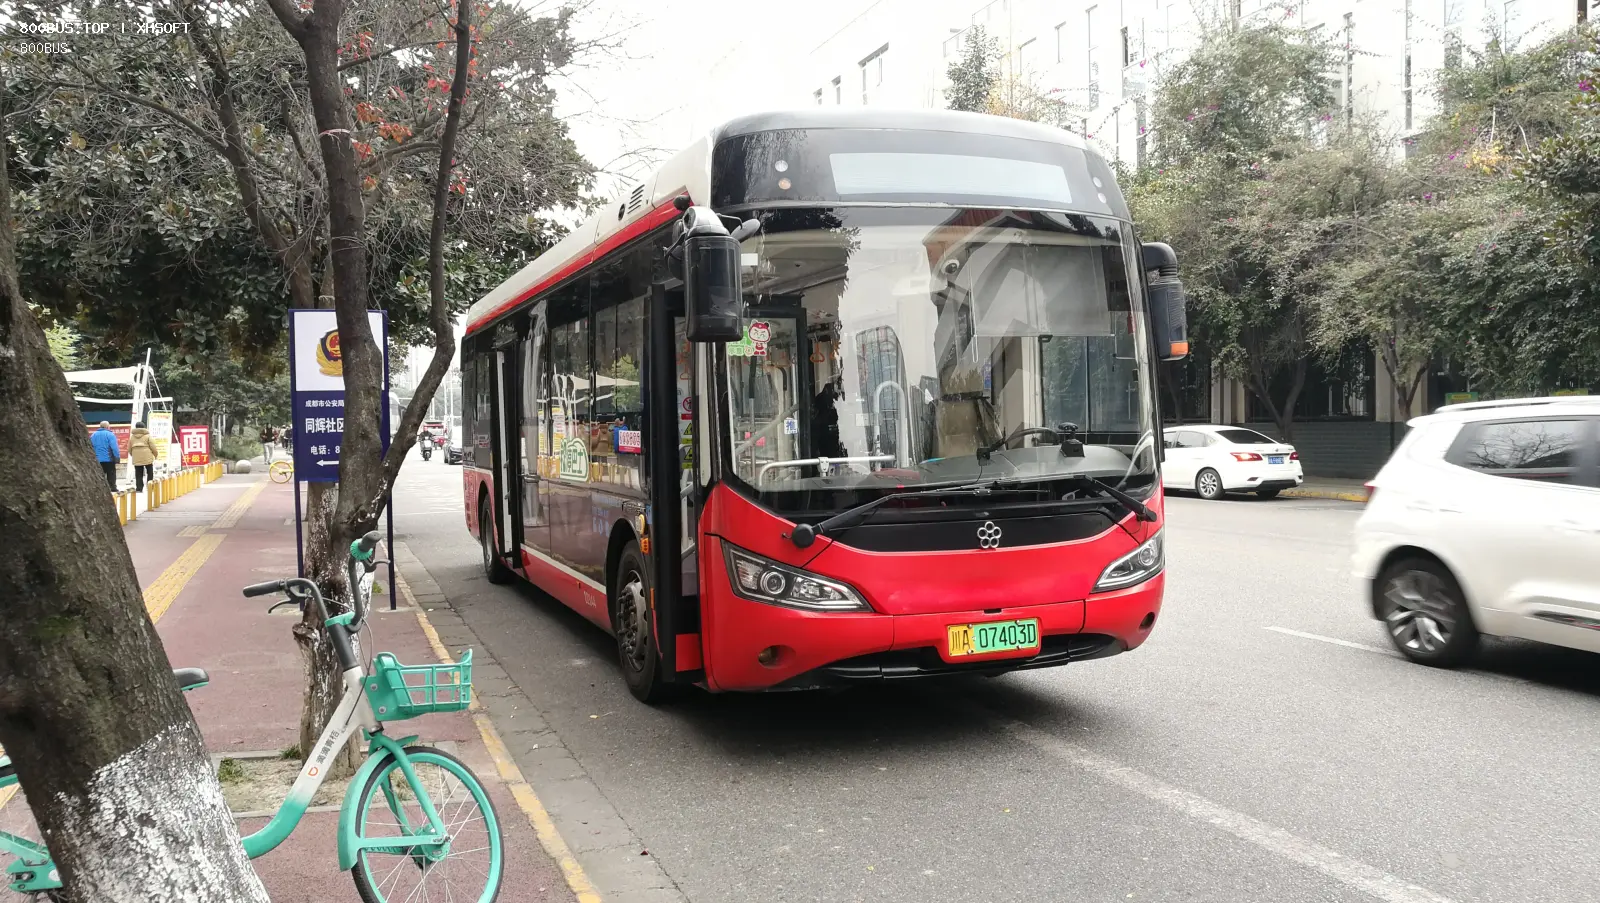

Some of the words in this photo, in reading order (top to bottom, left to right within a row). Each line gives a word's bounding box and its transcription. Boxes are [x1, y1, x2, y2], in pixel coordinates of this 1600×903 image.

[305, 399, 345, 407] 成都市公安局
[305, 417, 344, 434] 同辉社区
[181, 428, 208, 455] 面
